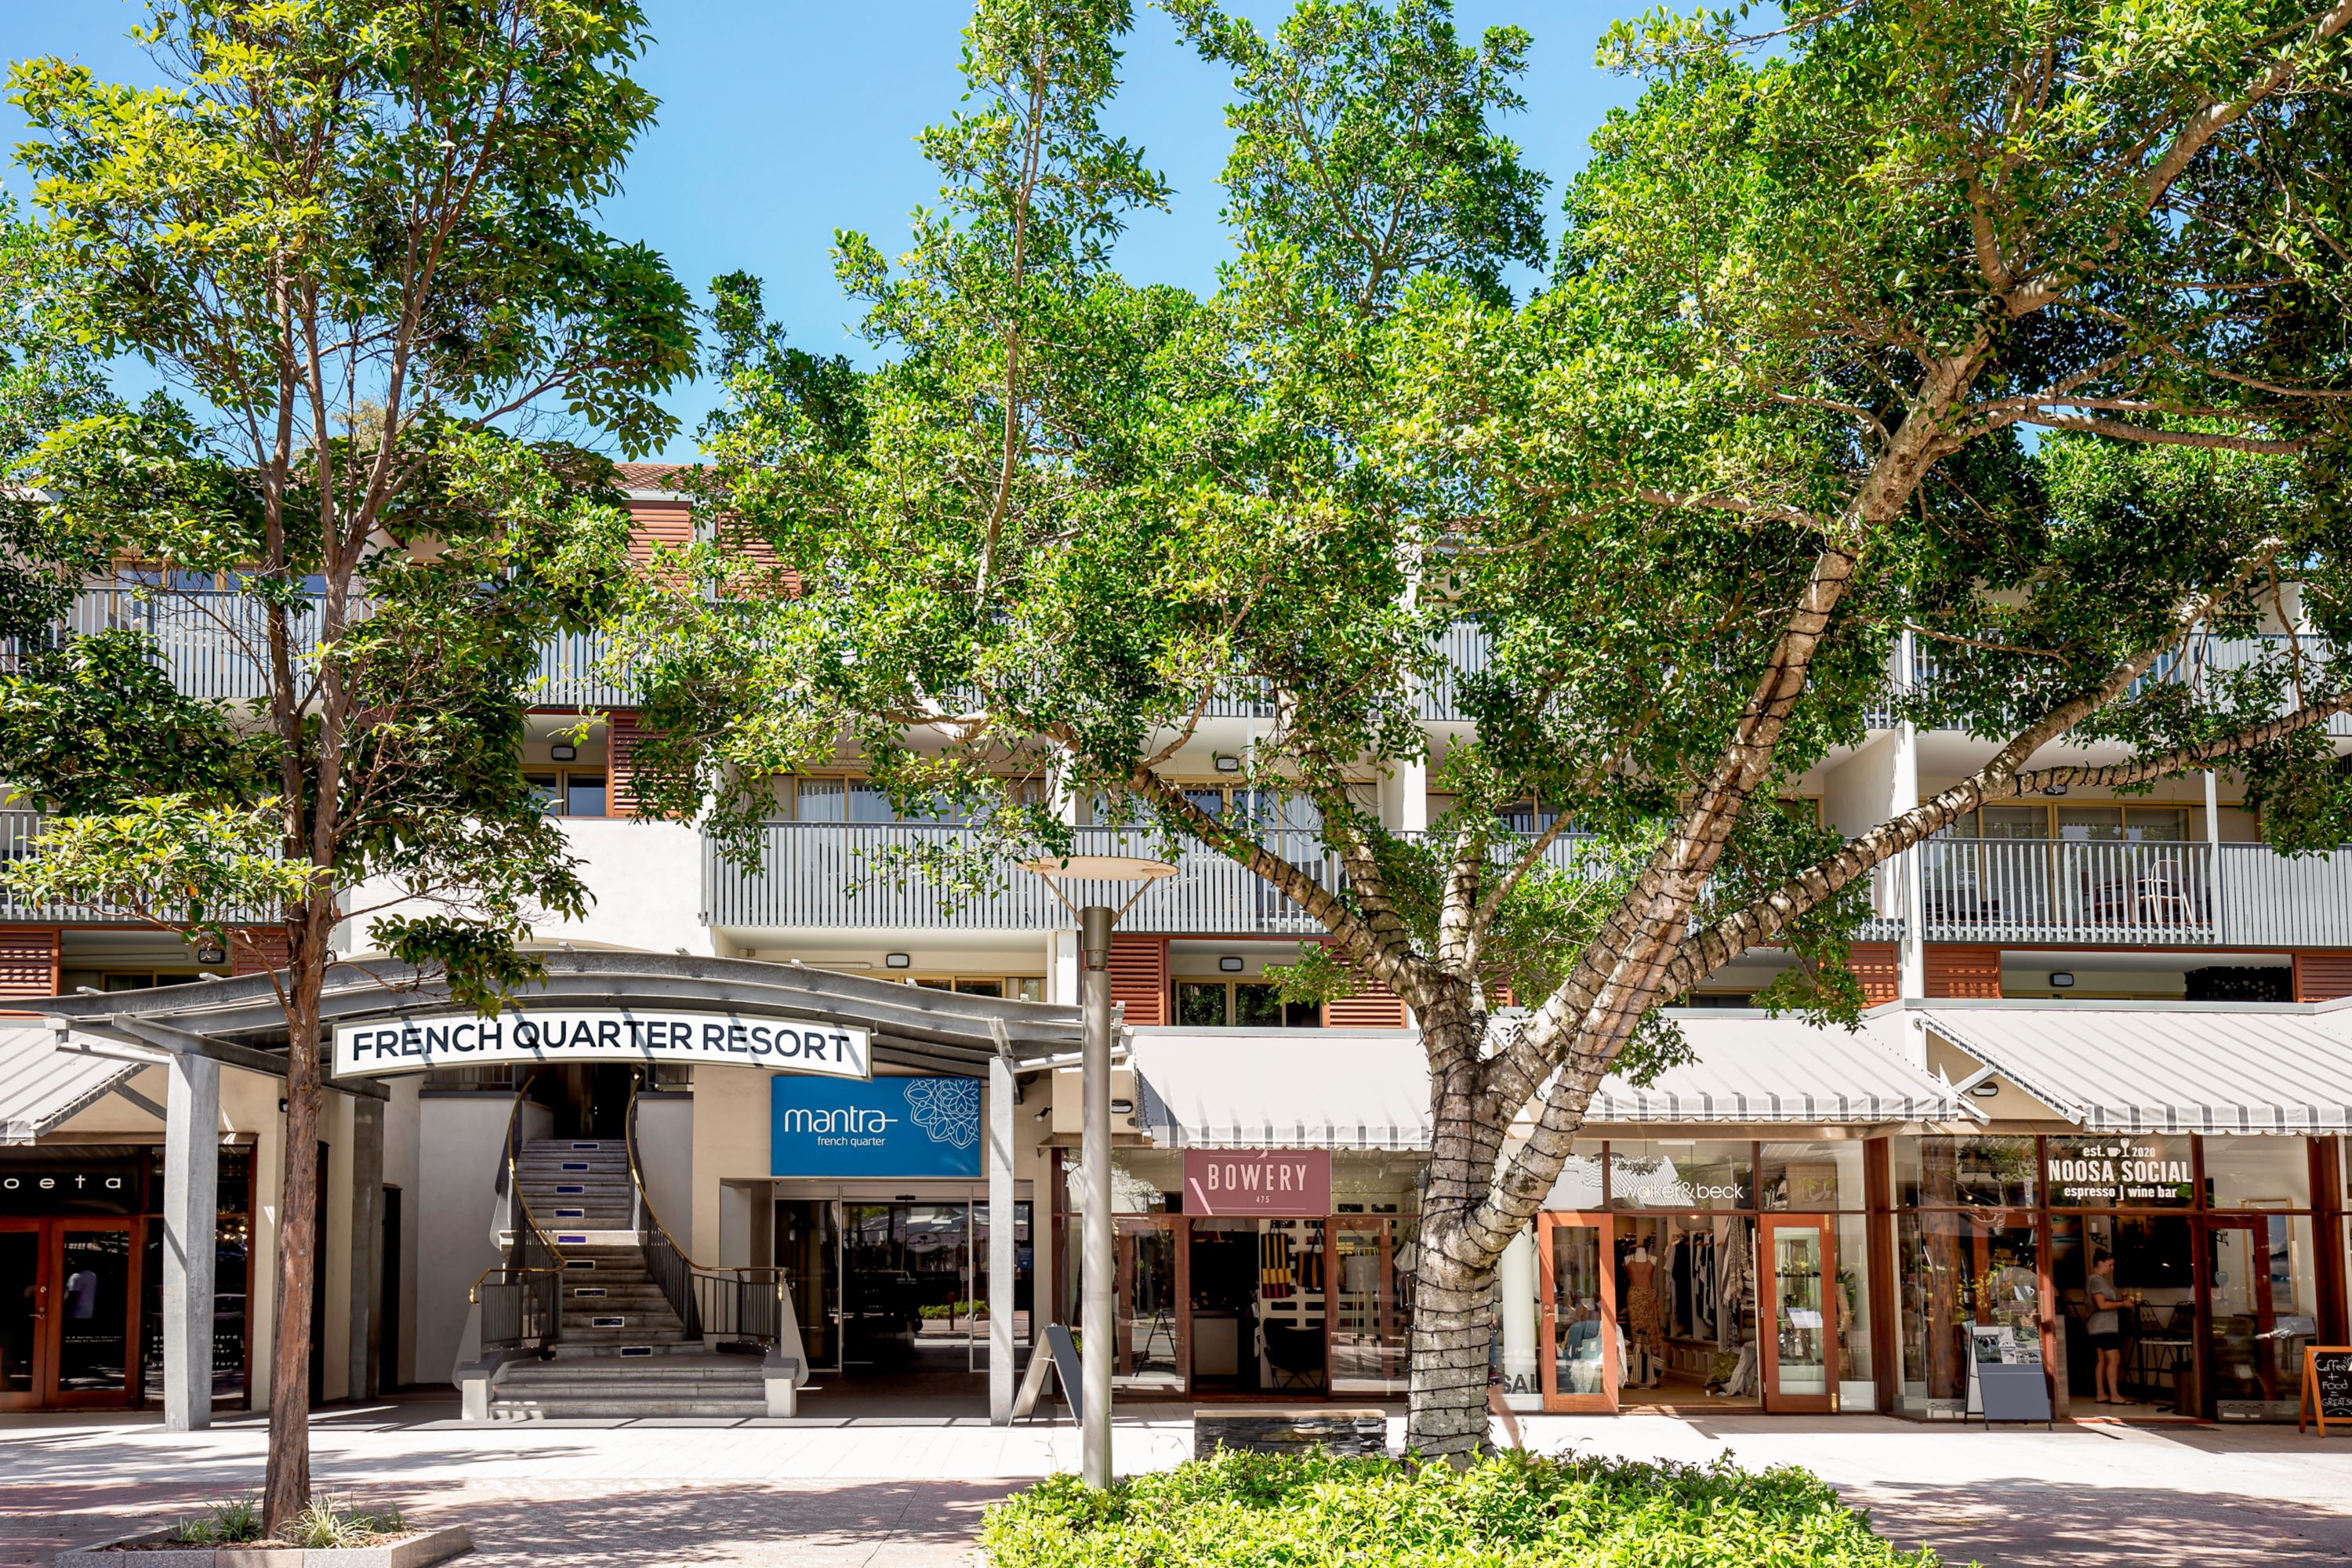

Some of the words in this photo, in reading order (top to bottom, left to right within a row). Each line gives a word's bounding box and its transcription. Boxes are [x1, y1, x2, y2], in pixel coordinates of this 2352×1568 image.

[353, 1022, 503, 1061] FRENCH
[512, 1020, 693, 1049] QUARTER
[702, 1023, 850, 1062] RESORT
[784, 1105, 898, 1133] mantra
[817, 1136, 848, 1146] french
[850, 1137, 886, 1148] quarter
[2082, 1145, 2106, 1157] est.
[2132, 1146, 2156, 1158] 2020
[1207, 1163, 1307, 1191] BOWERY
[2048, 1160, 2115, 1182] NOOSA
[2121, 1160, 2193, 1182] SOCIAL
[1623, 1181, 1744, 1200] walker&beck
[2063, 1186, 2116, 1200] espresso
[2127, 1185, 2155, 1198] wine
[2157, 1185, 2178, 1198] bar
[2315, 1359, 2347, 1371] Coffee
